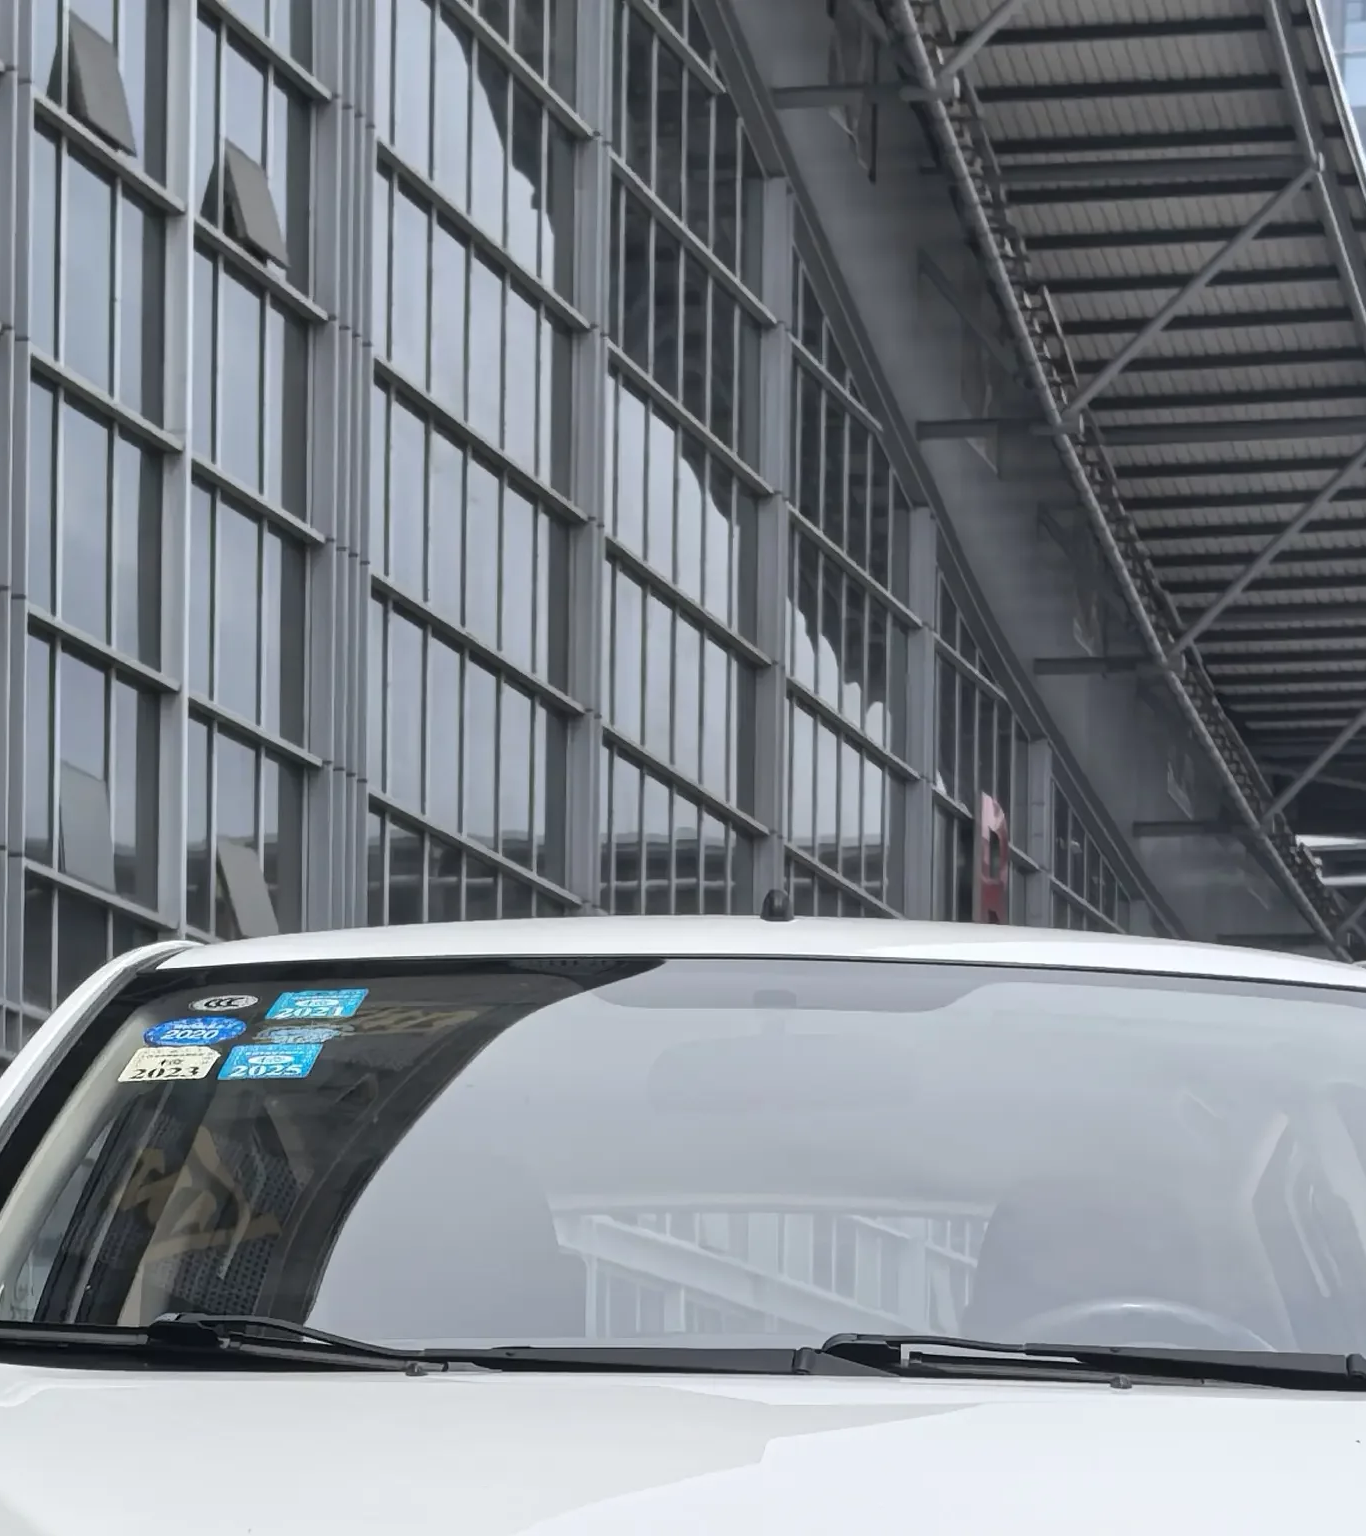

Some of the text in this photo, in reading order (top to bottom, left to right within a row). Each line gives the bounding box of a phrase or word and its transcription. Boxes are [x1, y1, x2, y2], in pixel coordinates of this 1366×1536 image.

[275, 1006, 344, 1020] 2021
[160, 1029, 220, 1040] 2020
[129, 1066, 200, 1079] 2023
[229, 1064, 303, 1079] 2025
